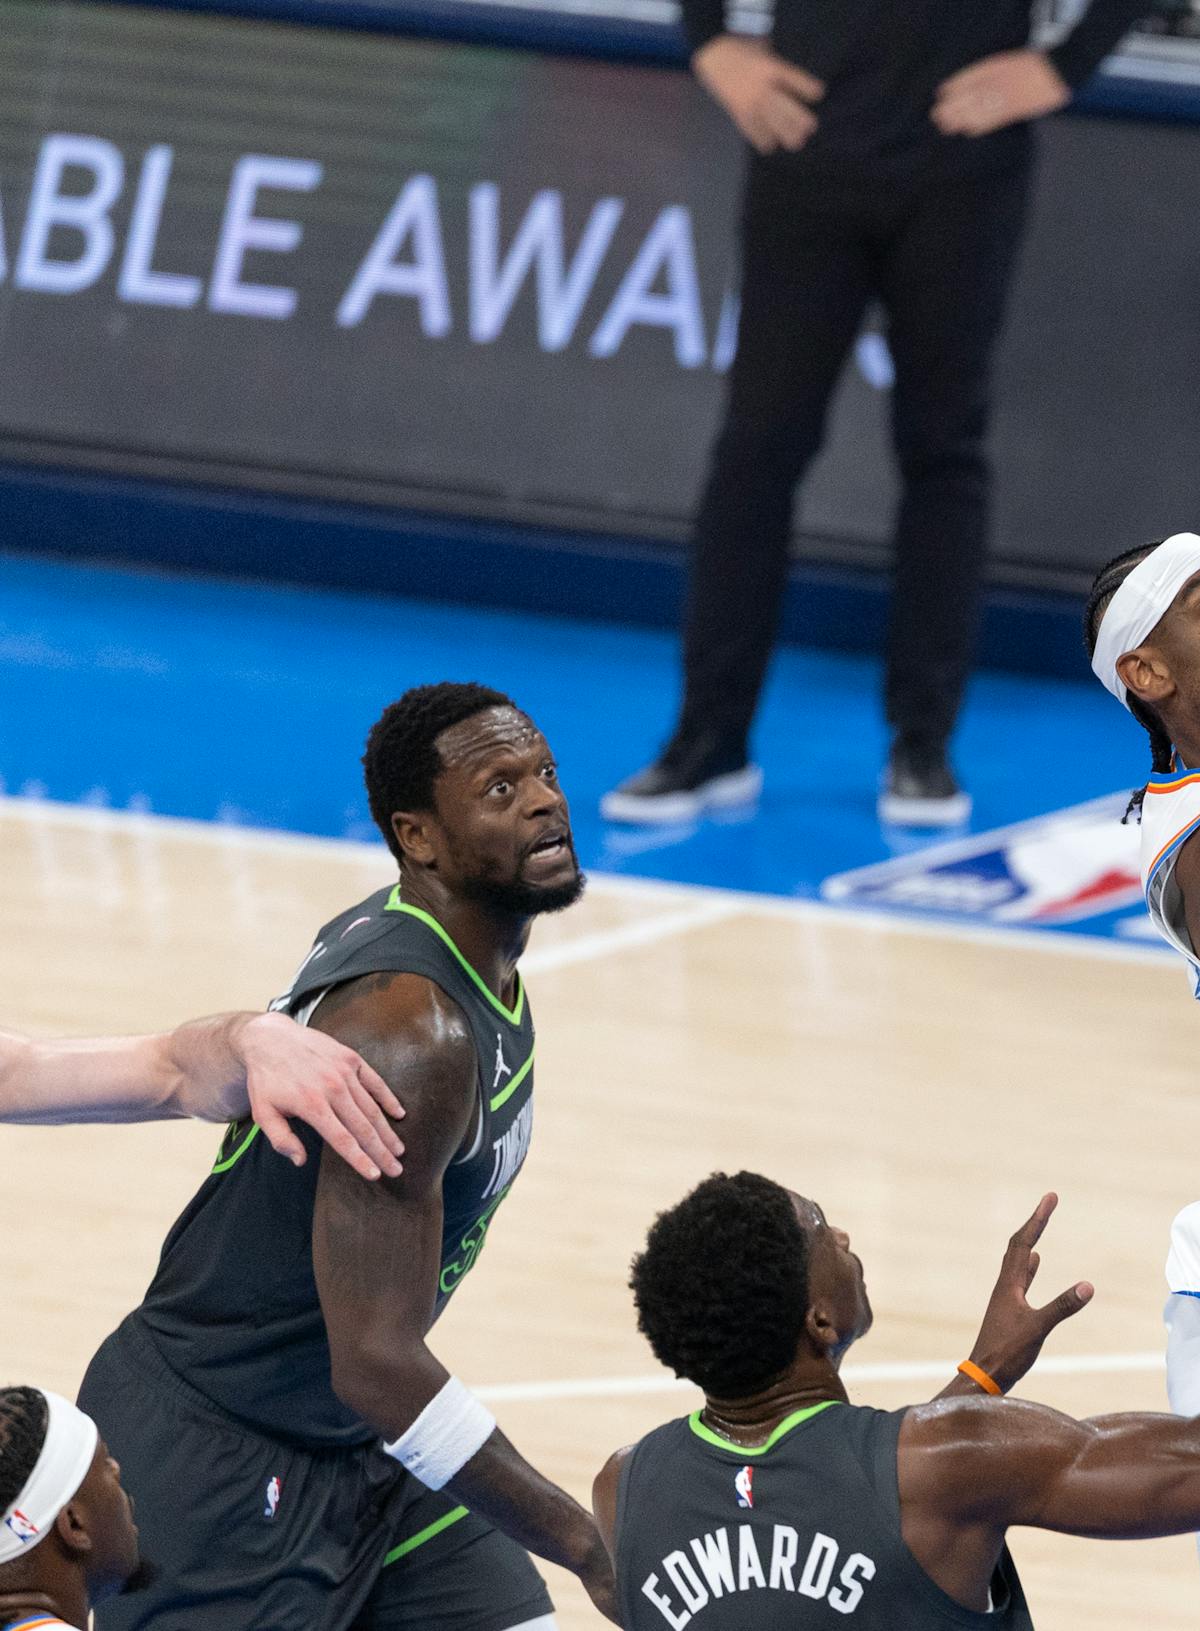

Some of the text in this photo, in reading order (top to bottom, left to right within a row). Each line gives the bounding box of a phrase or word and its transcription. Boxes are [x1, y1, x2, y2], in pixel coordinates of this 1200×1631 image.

[0, 133, 740, 374] BLE AWA
[641, 1524, 876, 1631] EDWARDS
